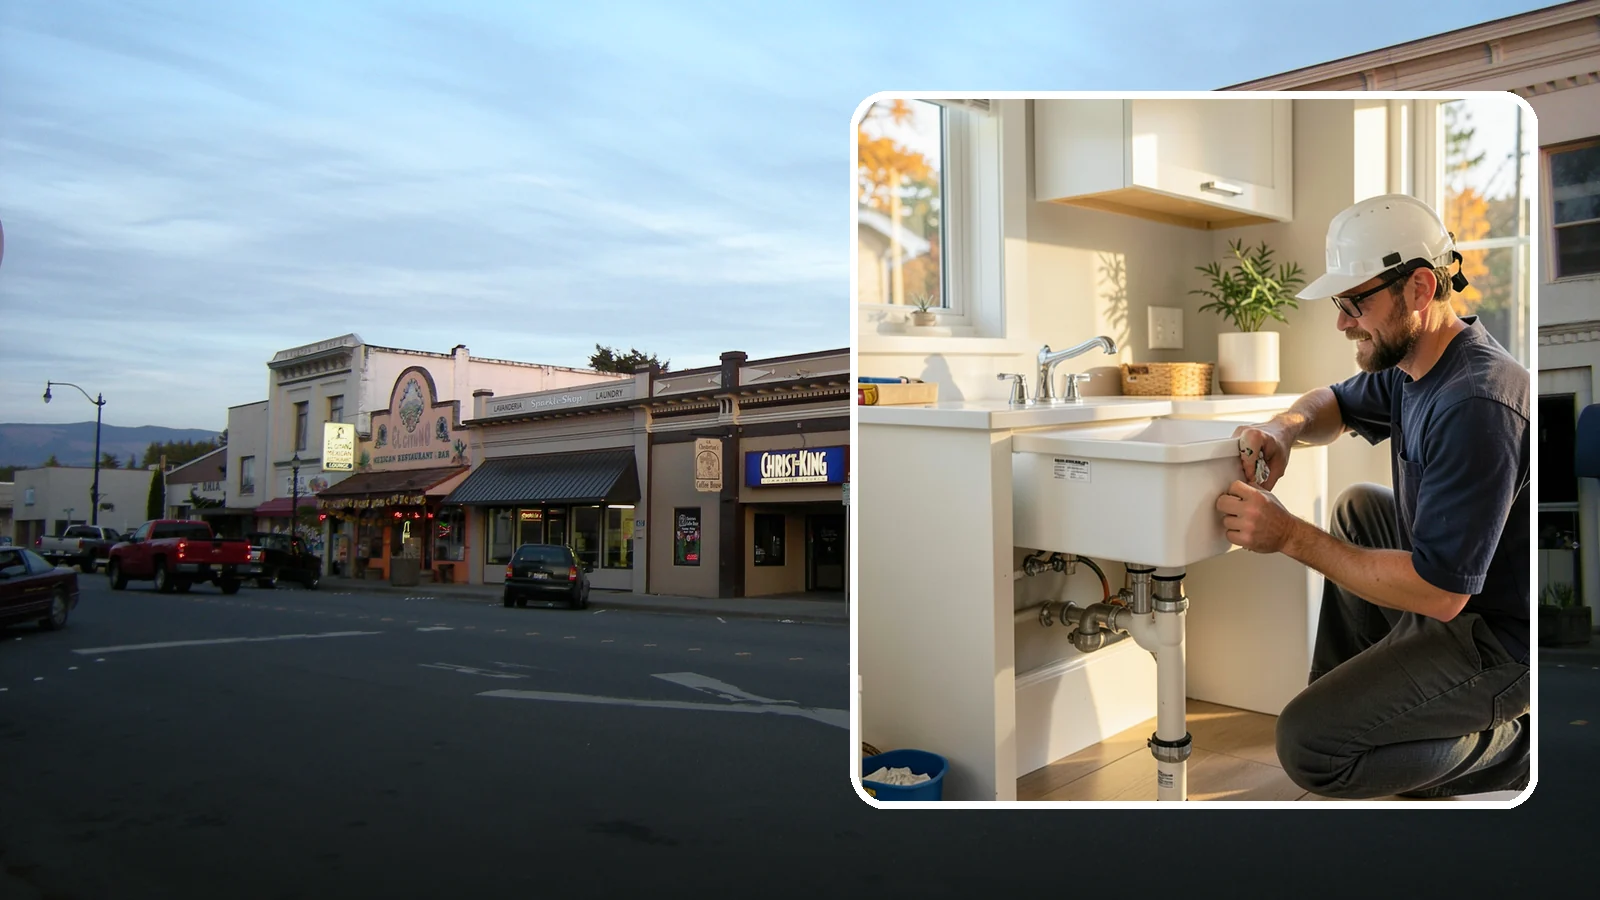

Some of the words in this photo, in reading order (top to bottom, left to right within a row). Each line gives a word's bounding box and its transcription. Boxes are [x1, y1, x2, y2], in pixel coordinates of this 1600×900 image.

[562, 395, 582, 404] Shop
[595, 389, 623, 400] LAUNDRY
[493, 402, 522, 412] LAVANDERIA
[374, 455, 396, 464] MEXICAN
[397, 451, 433, 462] RESTAURANT
[438, 450, 450, 459] BAR
[761, 452, 797, 478] CHRIST
[799, 450, 827, 476] KING
